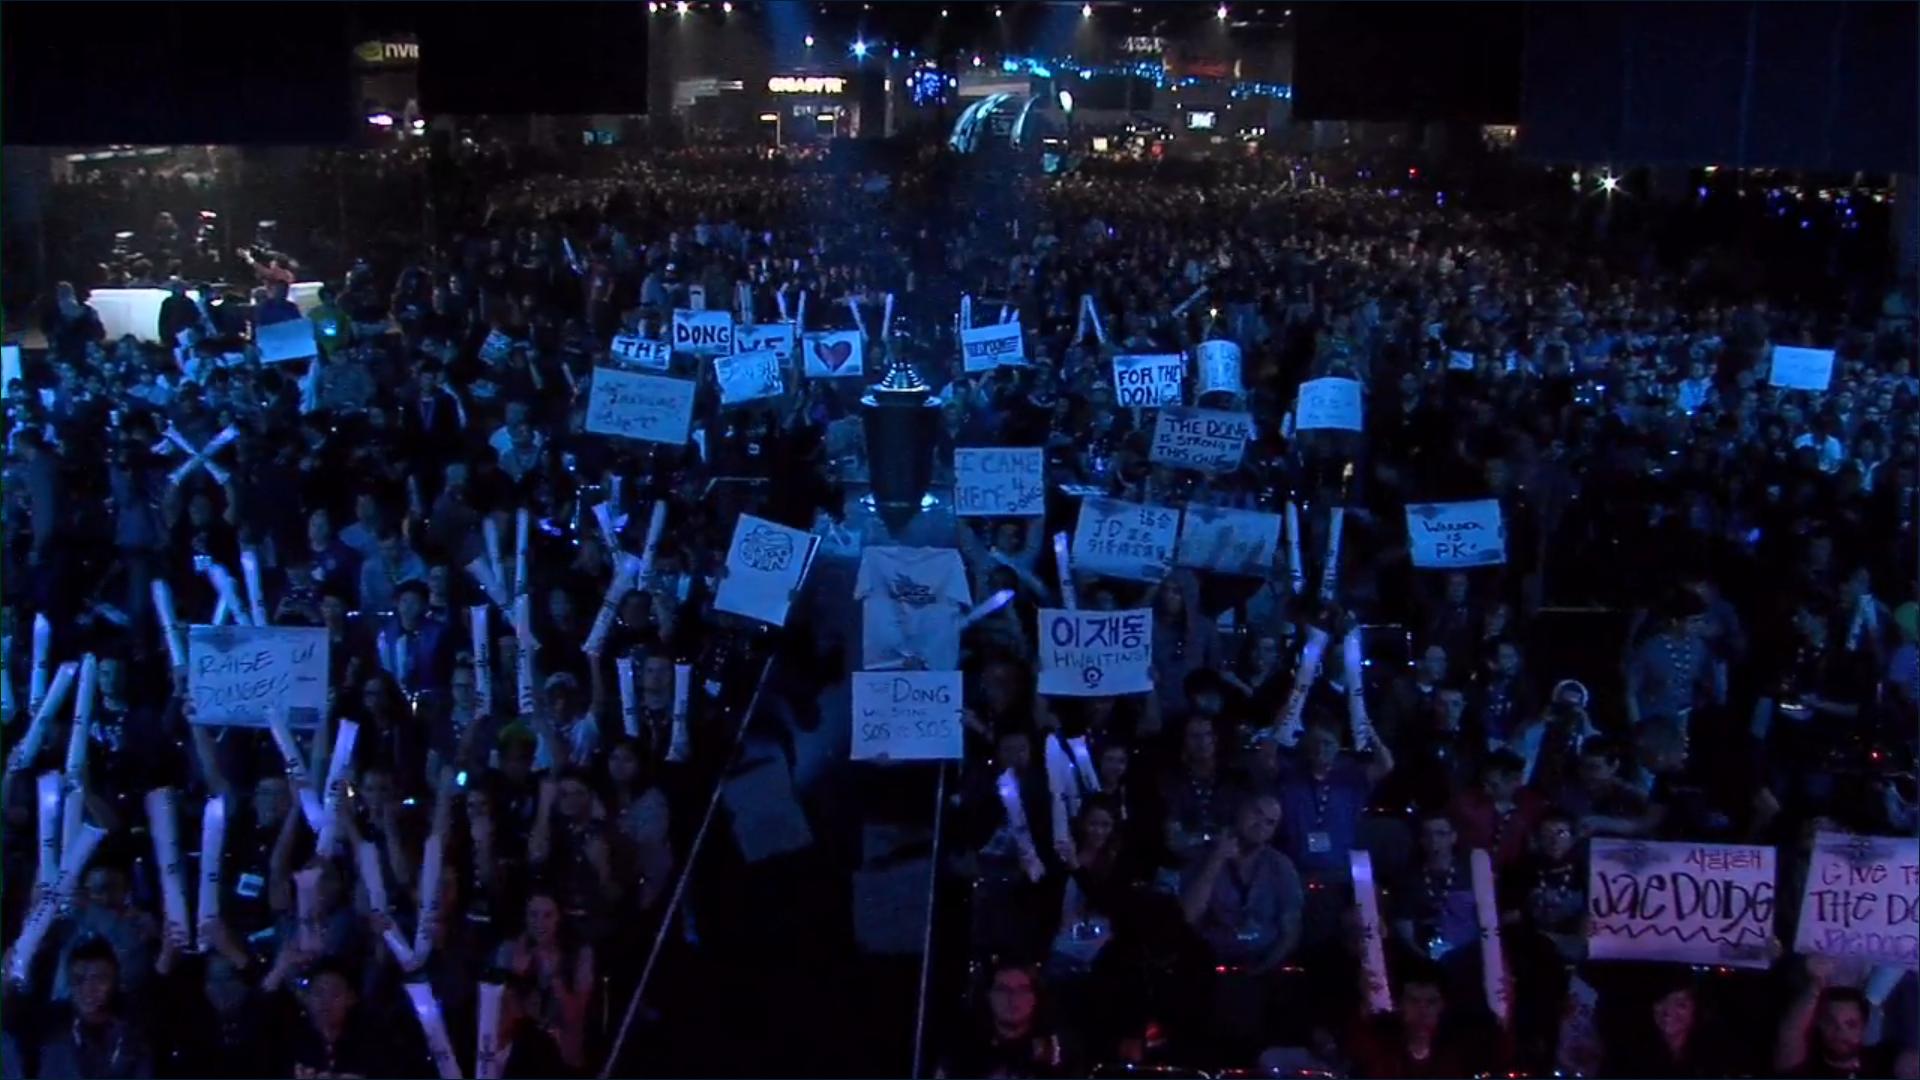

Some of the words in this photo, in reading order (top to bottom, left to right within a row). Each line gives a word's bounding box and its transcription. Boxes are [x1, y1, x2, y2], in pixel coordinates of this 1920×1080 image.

[676, 322, 730, 345] DONG
[617, 340, 667, 359] THE
[1117, 368, 1153, 387] FOR
[1165, 418, 1201, 433] THE
[982, 452, 1039, 473] CAME
[1156, 446, 1188, 460] THIS
[1051, 614, 1145, 649] 이재동
[199, 650, 274, 678] RAISE
